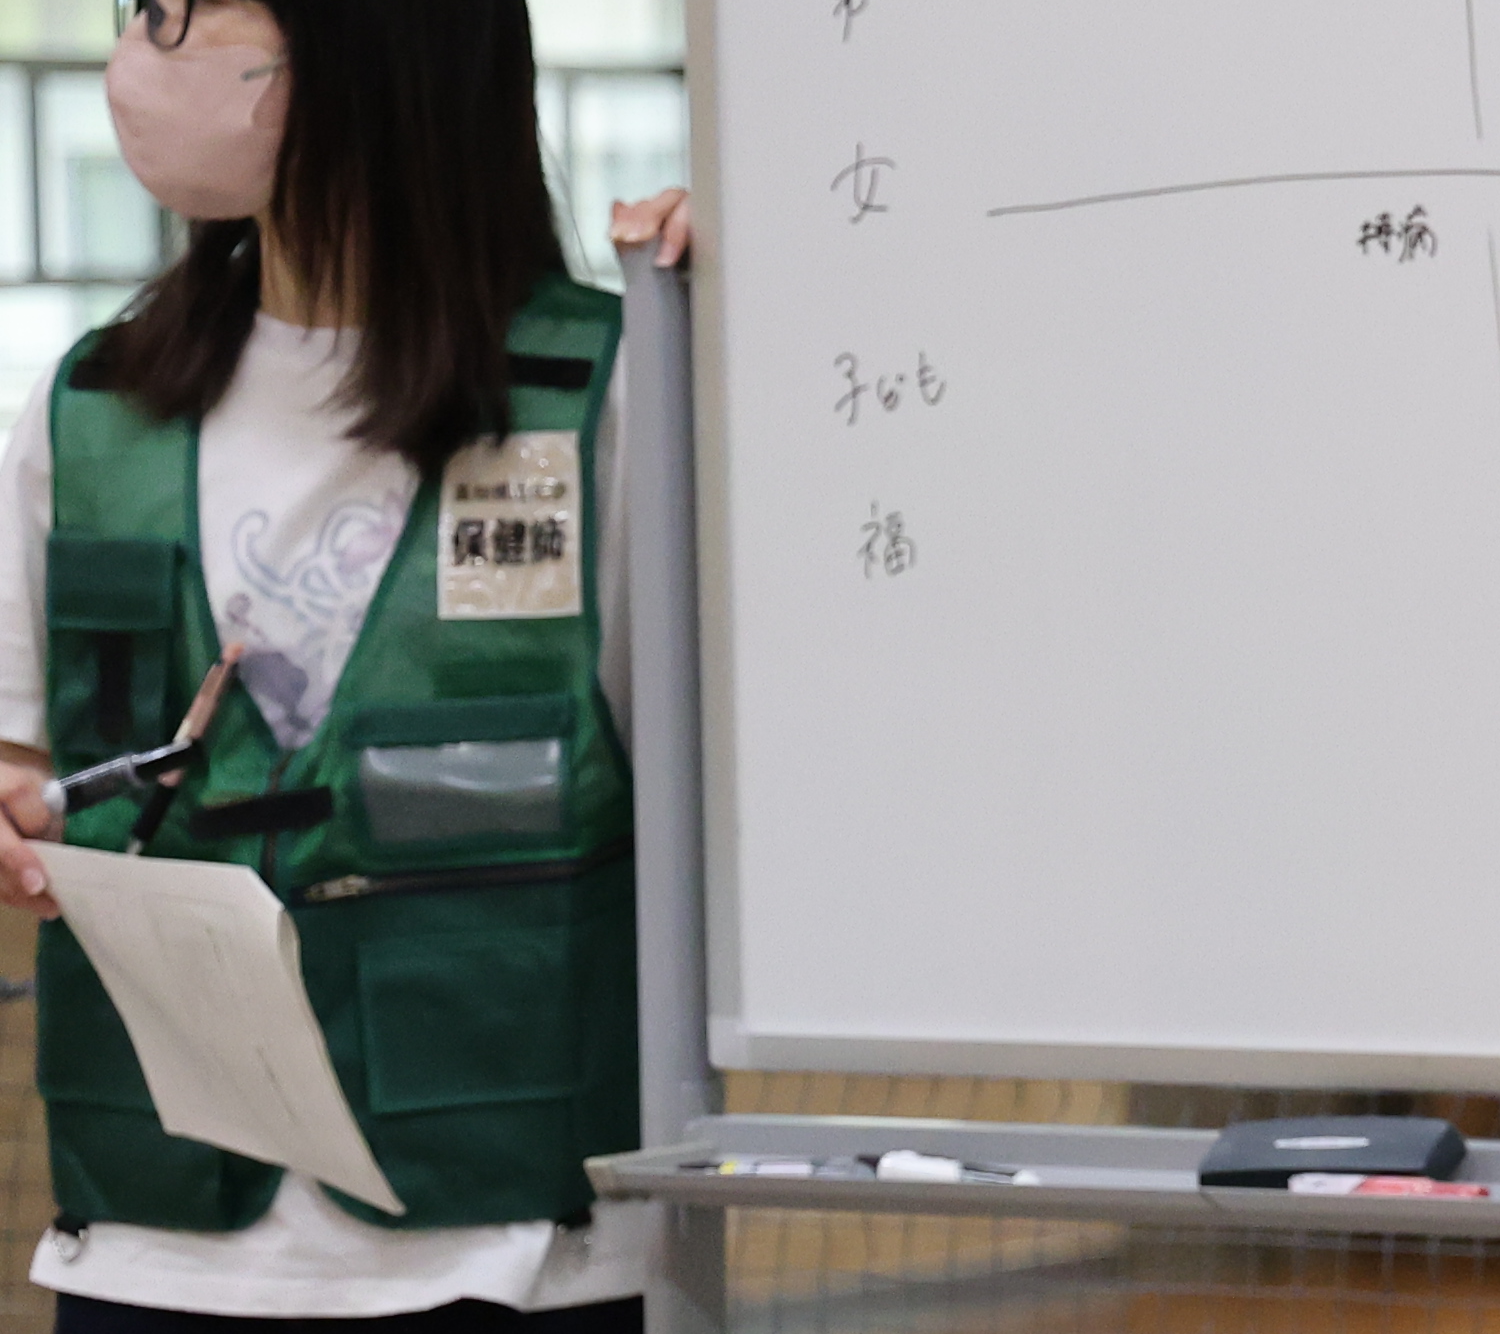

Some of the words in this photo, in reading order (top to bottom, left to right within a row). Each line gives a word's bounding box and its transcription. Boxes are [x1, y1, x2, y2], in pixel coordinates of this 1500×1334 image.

[831, 144, 895, 224] 女
[834, 353, 946, 426] 子ども
[858, 503, 915, 578] 福
